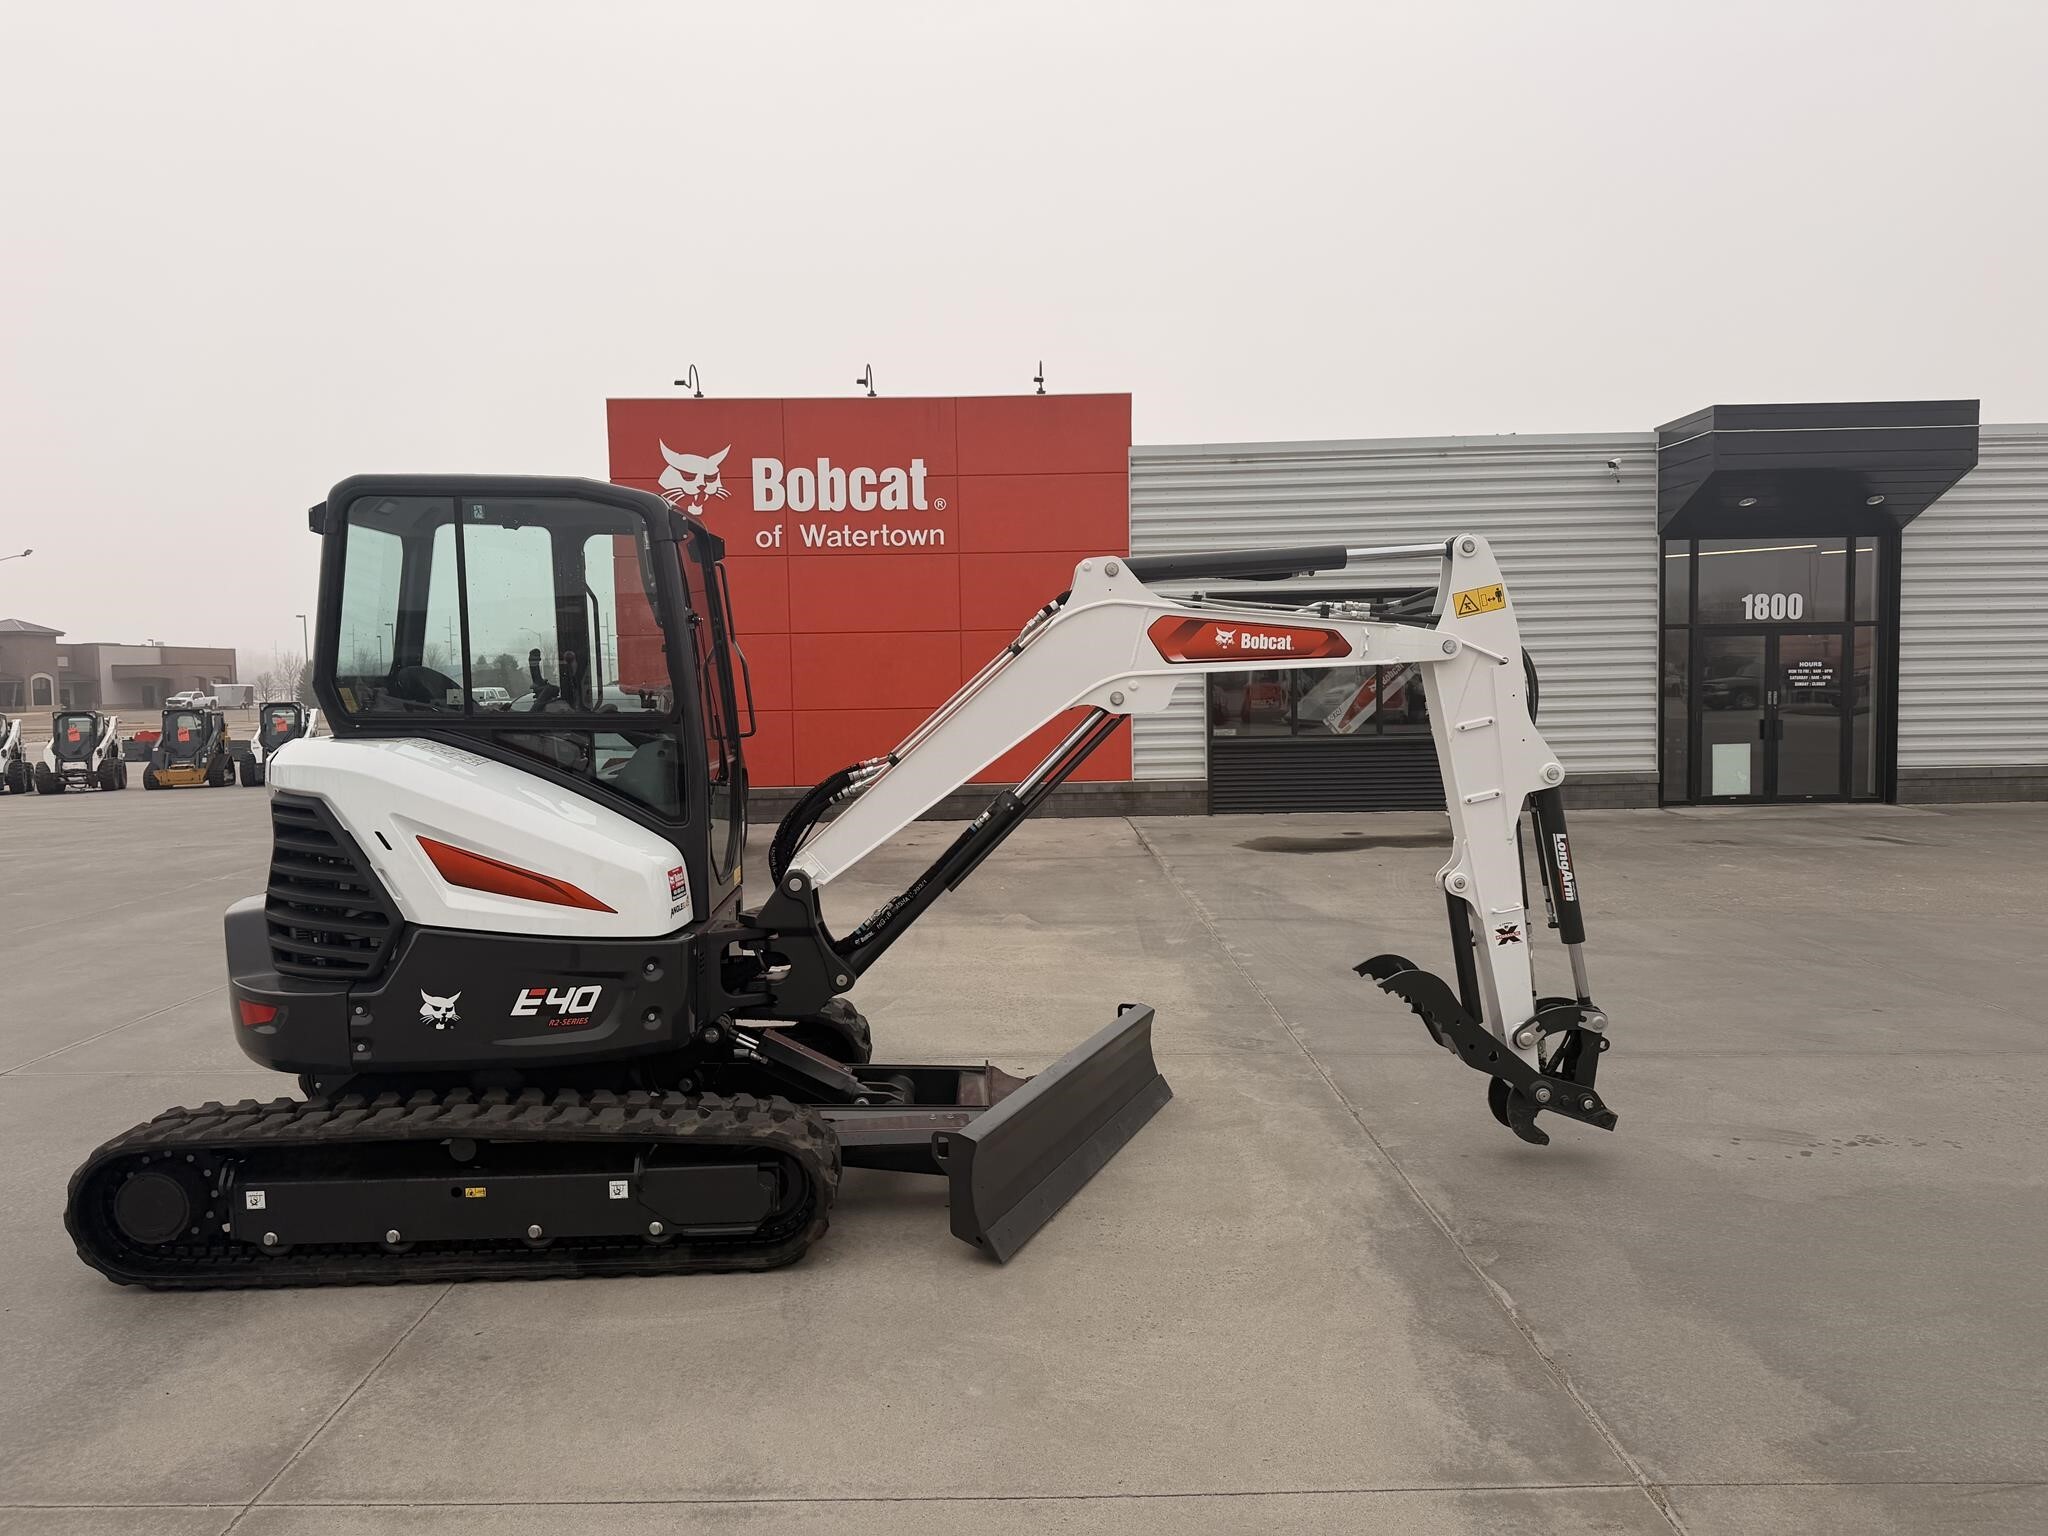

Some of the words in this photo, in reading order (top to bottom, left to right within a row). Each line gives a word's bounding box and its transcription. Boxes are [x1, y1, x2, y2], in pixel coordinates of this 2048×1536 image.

[751, 457, 929, 512] Bobcat
[755, 524, 783, 548] of
[800, 523, 945, 547] Watertown
[1741, 593, 1803, 620] 1800
[1241, 632, 1292, 650] Bobcat
[1553, 833, 1575, 901] LongArm
[510, 985, 602, 1016] E40
[549, 1017, 589, 1027] R2-SERIES
